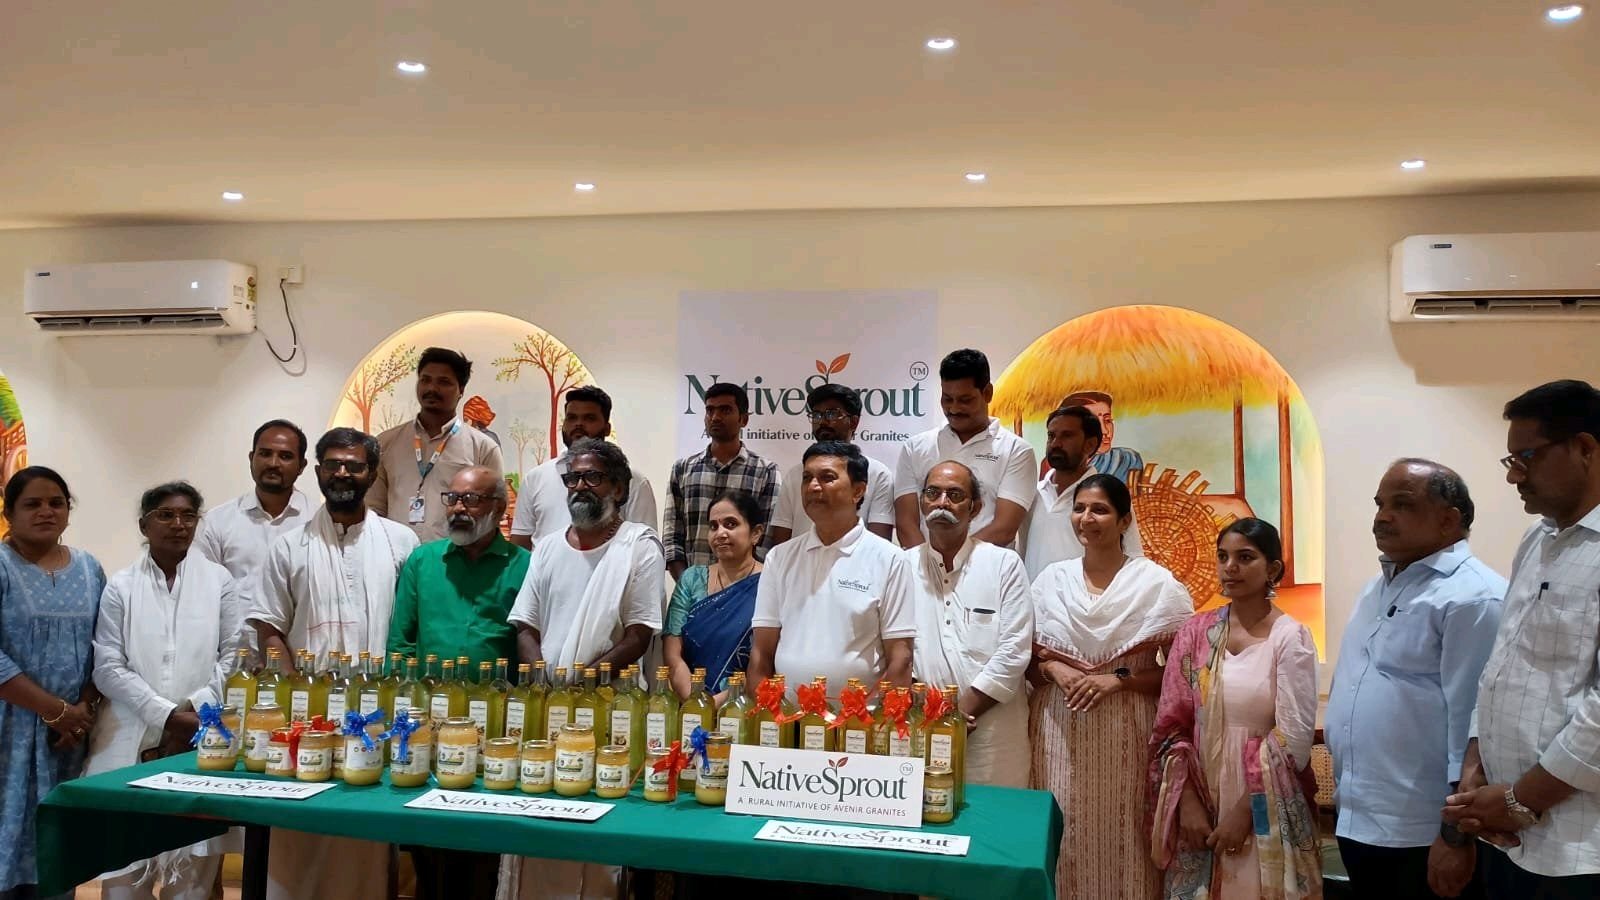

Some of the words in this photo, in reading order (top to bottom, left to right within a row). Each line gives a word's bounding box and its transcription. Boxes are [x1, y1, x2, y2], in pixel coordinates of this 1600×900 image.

[684, 375, 926, 417] NtiveSrout
[747, 428, 800, 440] initiative
[861, 429, 909, 441] Granites
[739, 760, 907, 802] NativeSprout
[748, 797, 774, 806] RURAL
[777, 800, 818, 810] INITIATIVE
[820, 803, 832, 811] OF
[834, 804, 863, 814] AVENIR
[866, 806, 906, 816] GRANITES
[773, 825, 954, 848] NativeSprout
